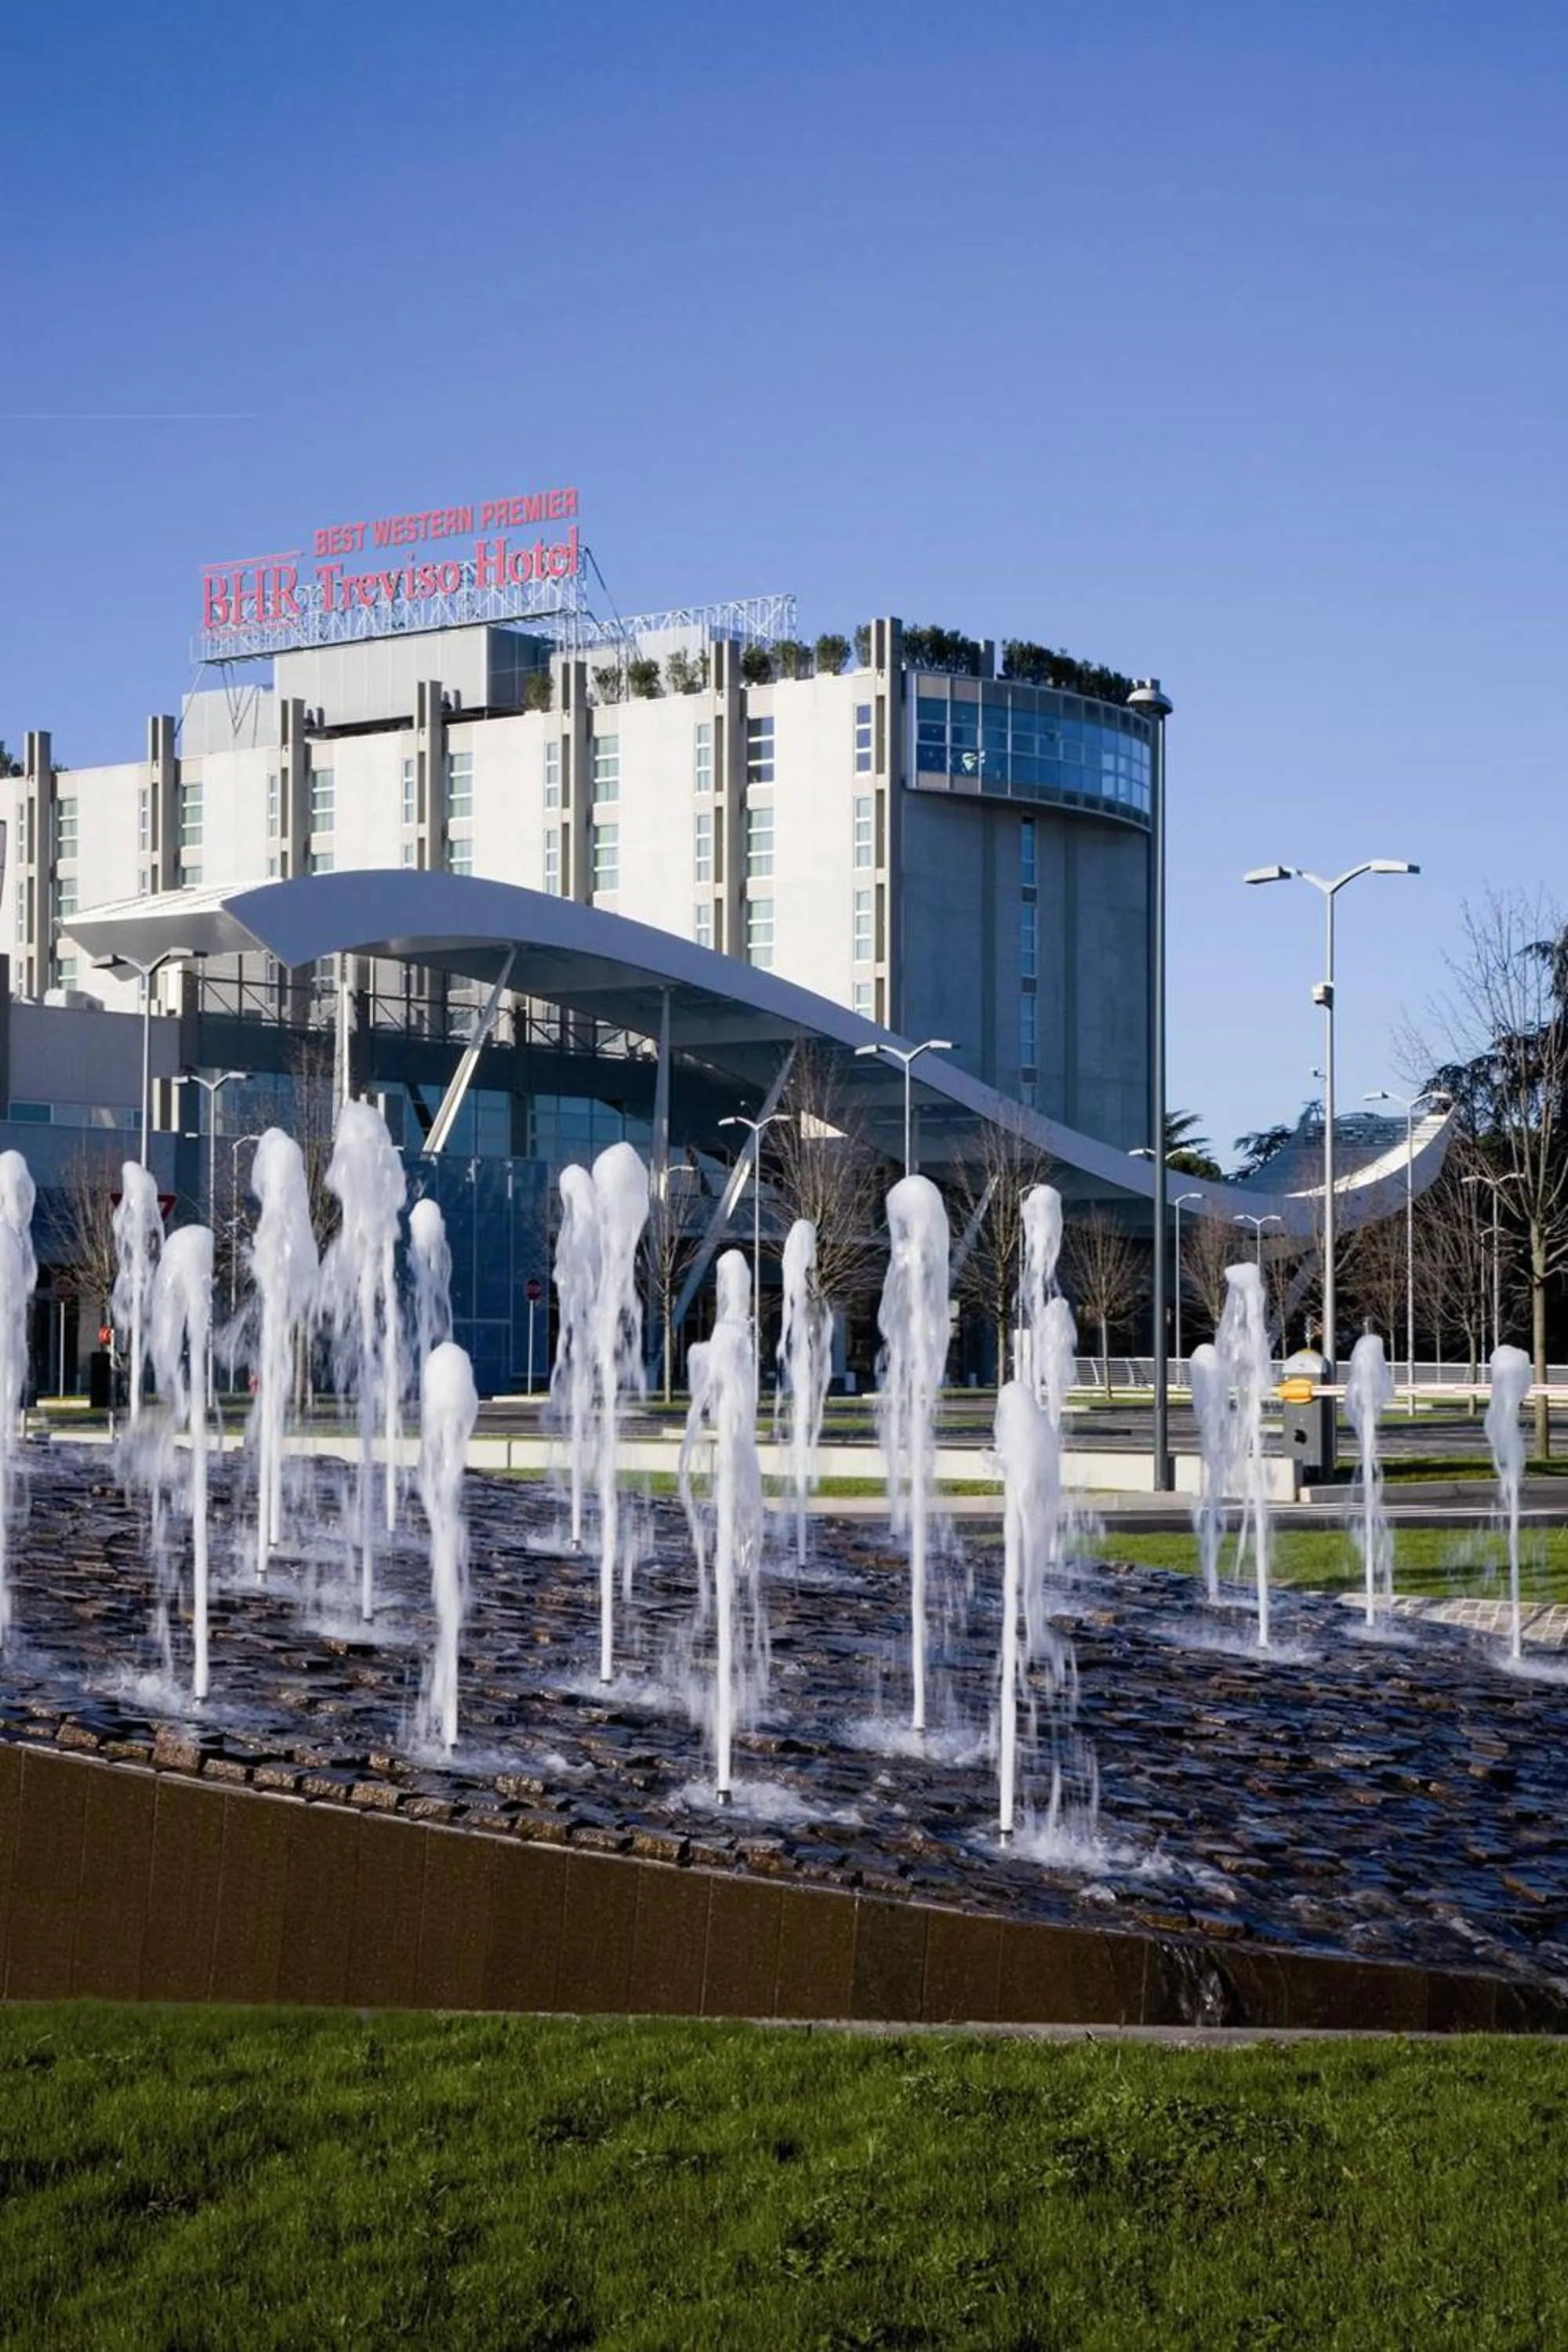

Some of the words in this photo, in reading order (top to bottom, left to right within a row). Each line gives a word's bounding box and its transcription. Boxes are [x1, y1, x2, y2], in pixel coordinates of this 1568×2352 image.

[314, 523, 367, 557] BEST
[373, 505, 474, 549] WESTERN
[481, 488, 579, 530] PREMIER
[202, 564, 302, 628] BHR
[314, 550, 461, 612] Treviso
[475, 524, 579, 589] Hotel
